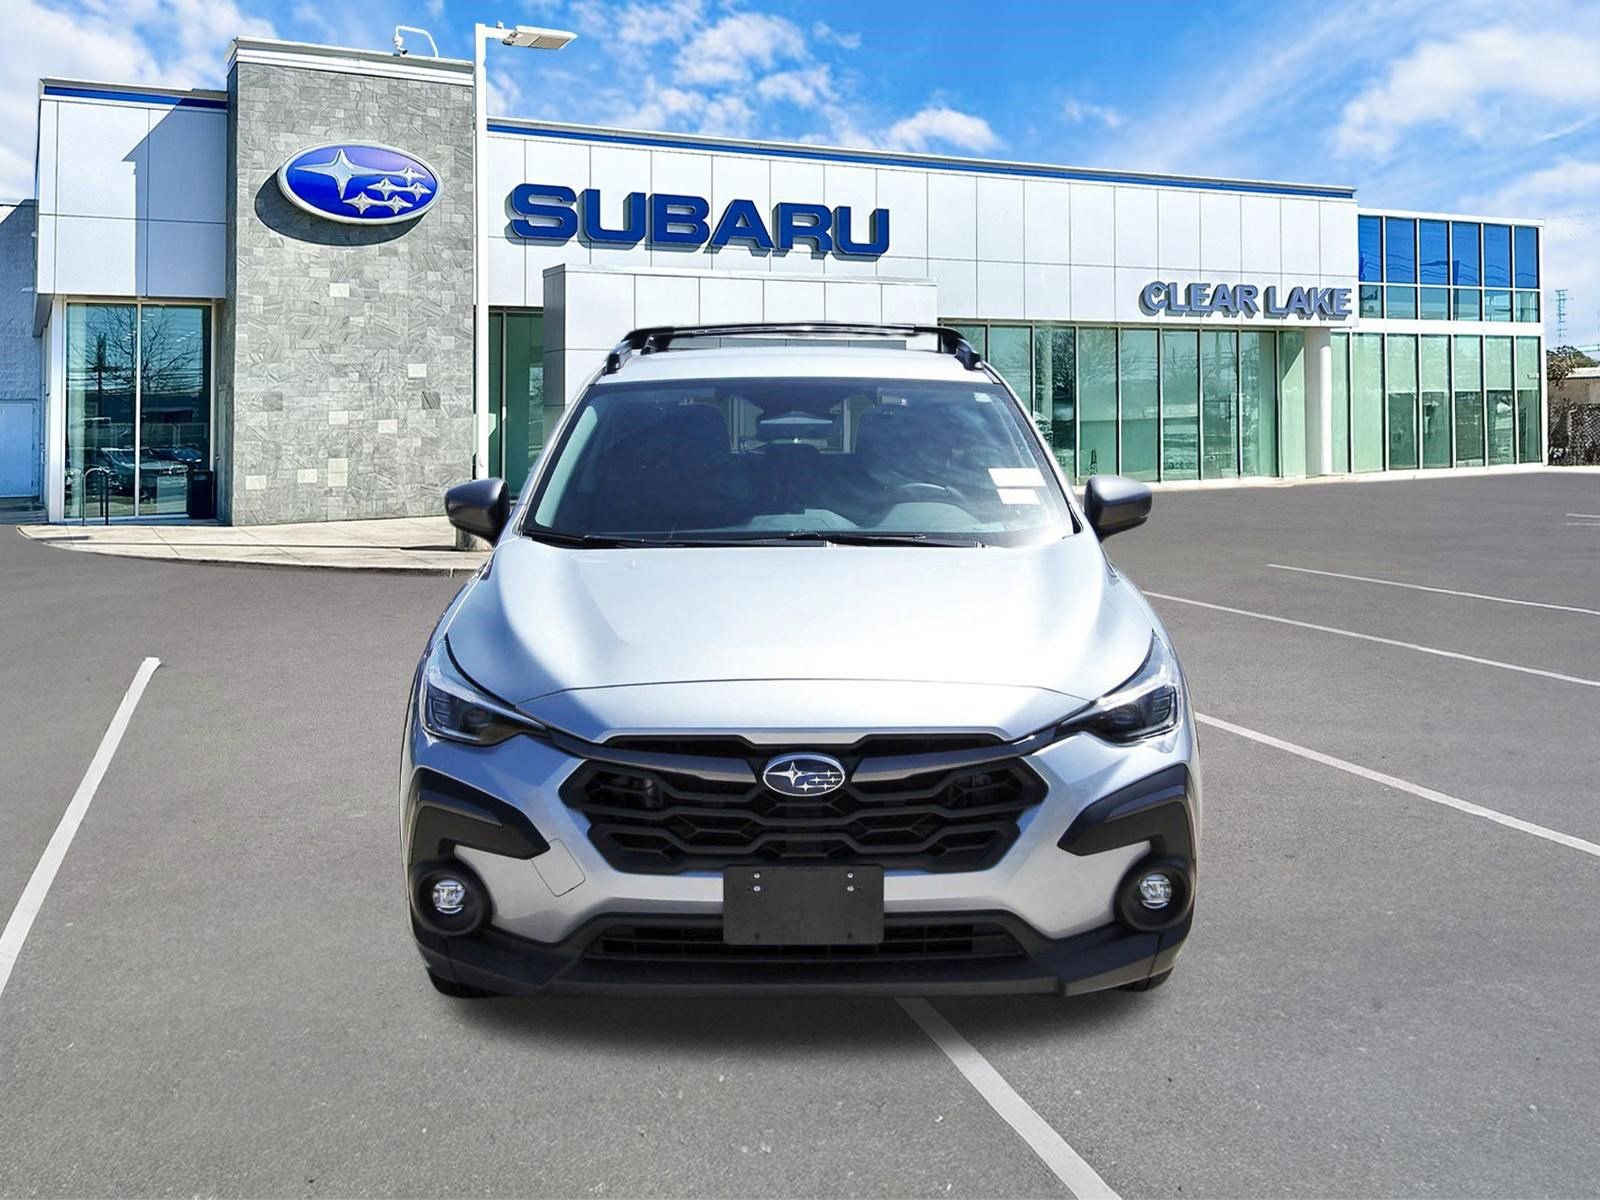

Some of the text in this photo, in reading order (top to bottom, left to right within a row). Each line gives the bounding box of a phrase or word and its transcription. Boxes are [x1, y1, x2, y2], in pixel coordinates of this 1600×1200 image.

[507, 183, 890, 258] SUBARU
[1141, 281, 1352, 319] CLEAR LAKE
